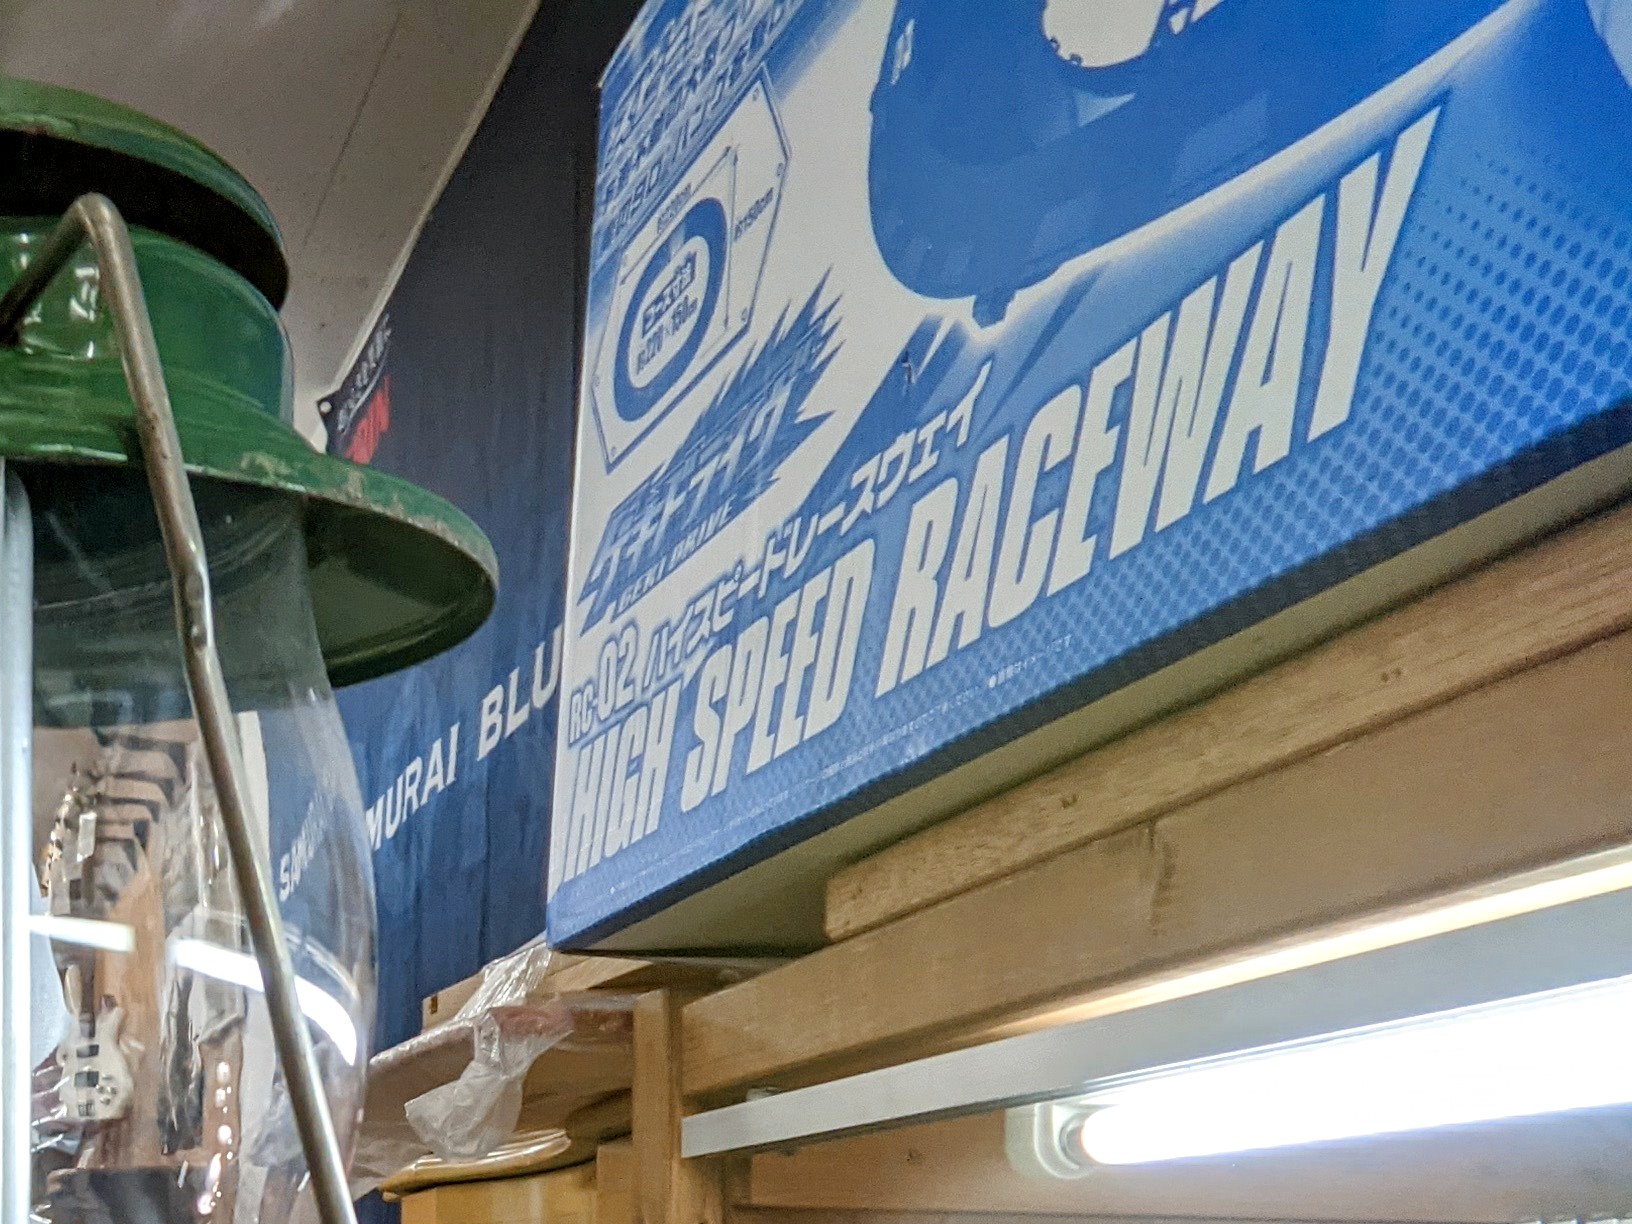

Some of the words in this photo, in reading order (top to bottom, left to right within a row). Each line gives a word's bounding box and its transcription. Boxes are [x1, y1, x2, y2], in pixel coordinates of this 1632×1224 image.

[563, 680, 682, 884] HIGH
[681, 539, 875, 812] SPEED
[875, 104, 1444, 698] RACEWAY
[570, 632, 639, 742] RC-02
[645, 362, 992, 688] ハイスピードレースウェイ
[670, 502, 734, 570] DRIVE
